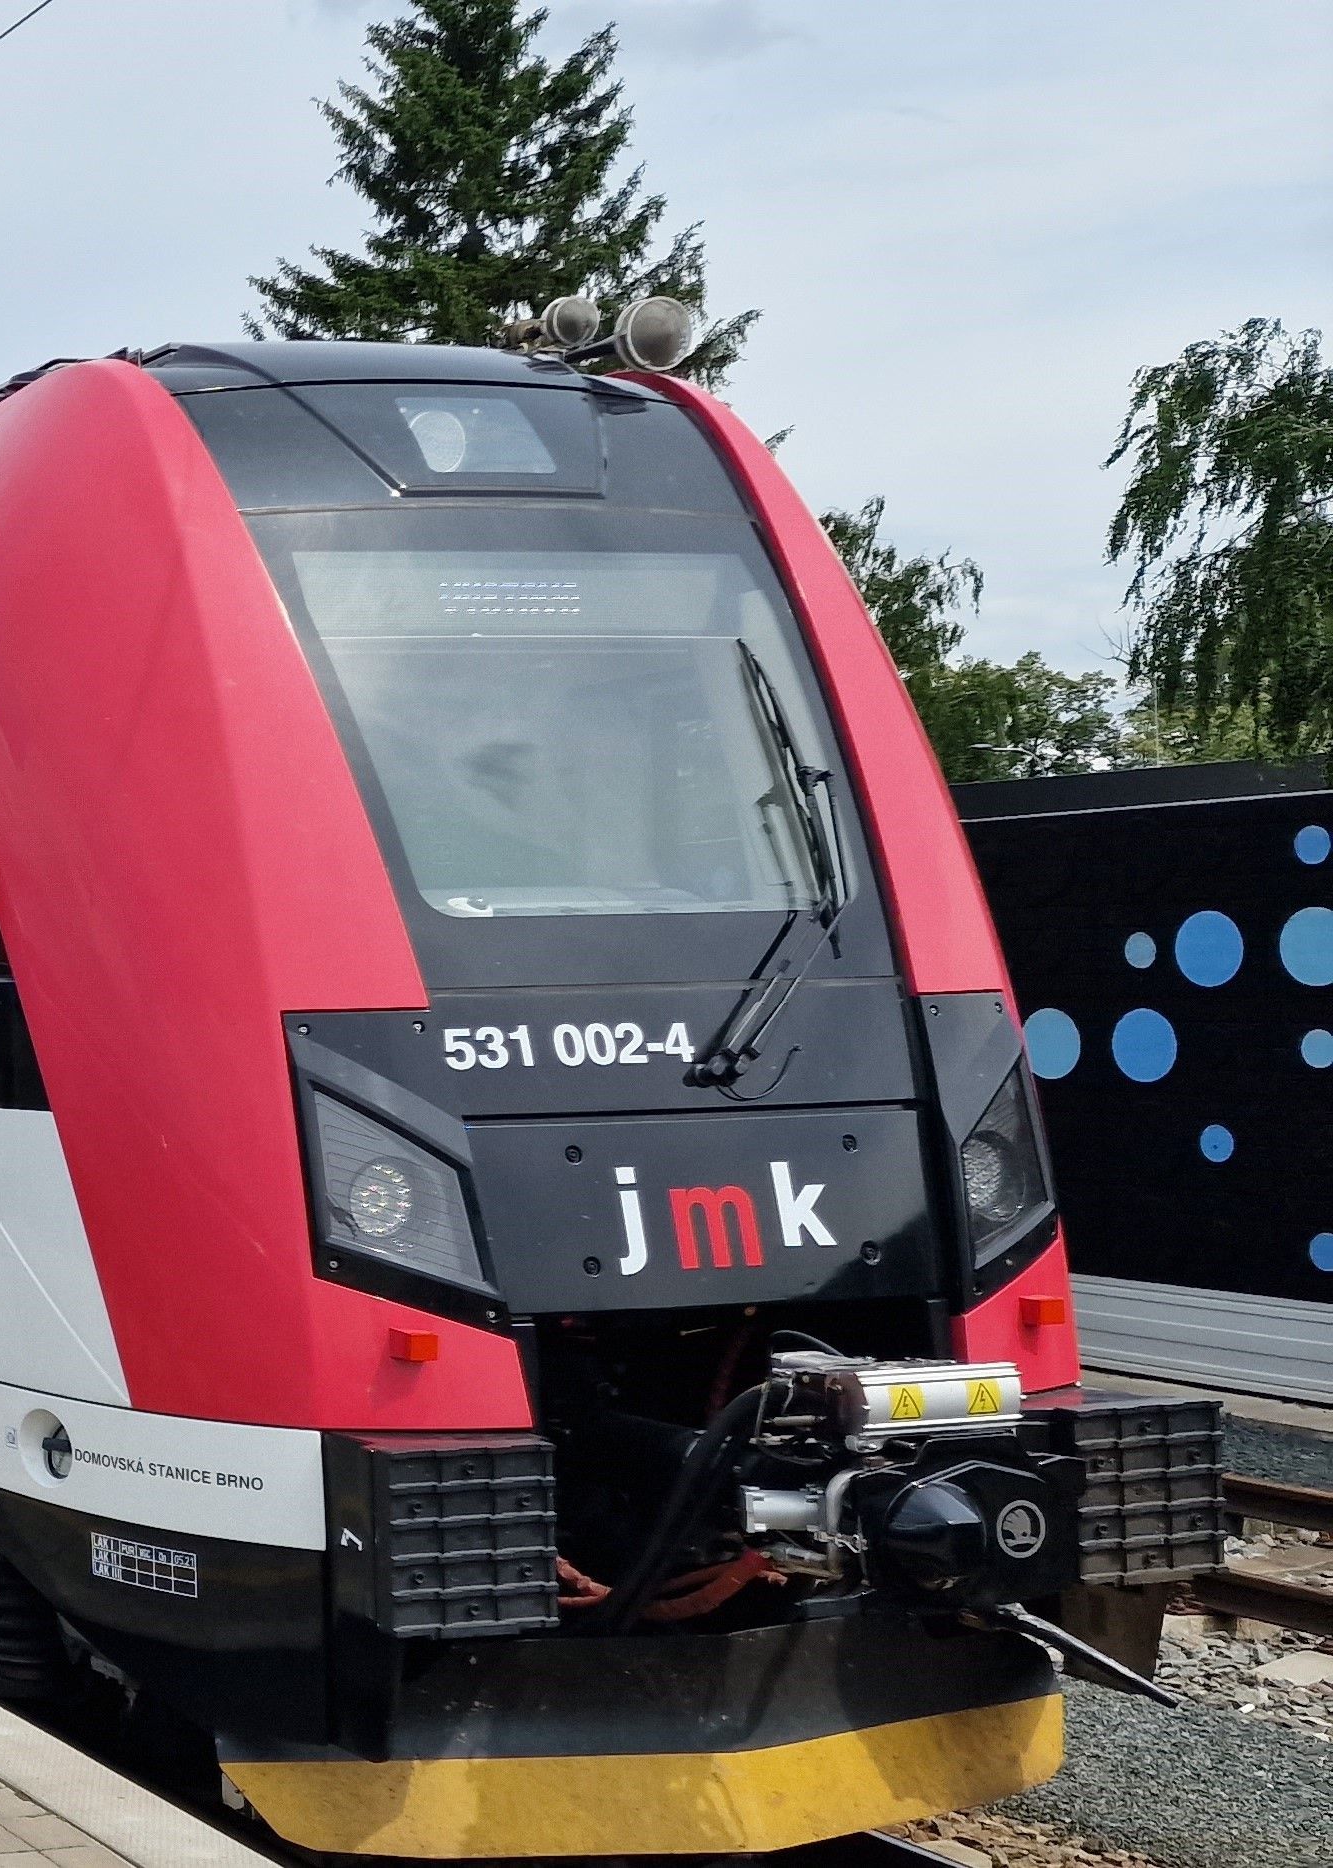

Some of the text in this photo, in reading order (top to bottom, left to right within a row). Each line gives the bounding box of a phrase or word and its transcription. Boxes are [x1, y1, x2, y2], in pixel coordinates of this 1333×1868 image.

[443, 1022, 695, 1071] 531 002-4
[614, 1161, 838, 1276] jmk
[73, 1448, 264, 1491] DOMOVSKÁ STANICE BRNO
[93, 1534, 109, 1548] LAK
[93, 1548, 109, 1562] LAK
[93, 1561, 110, 1576] LAK
